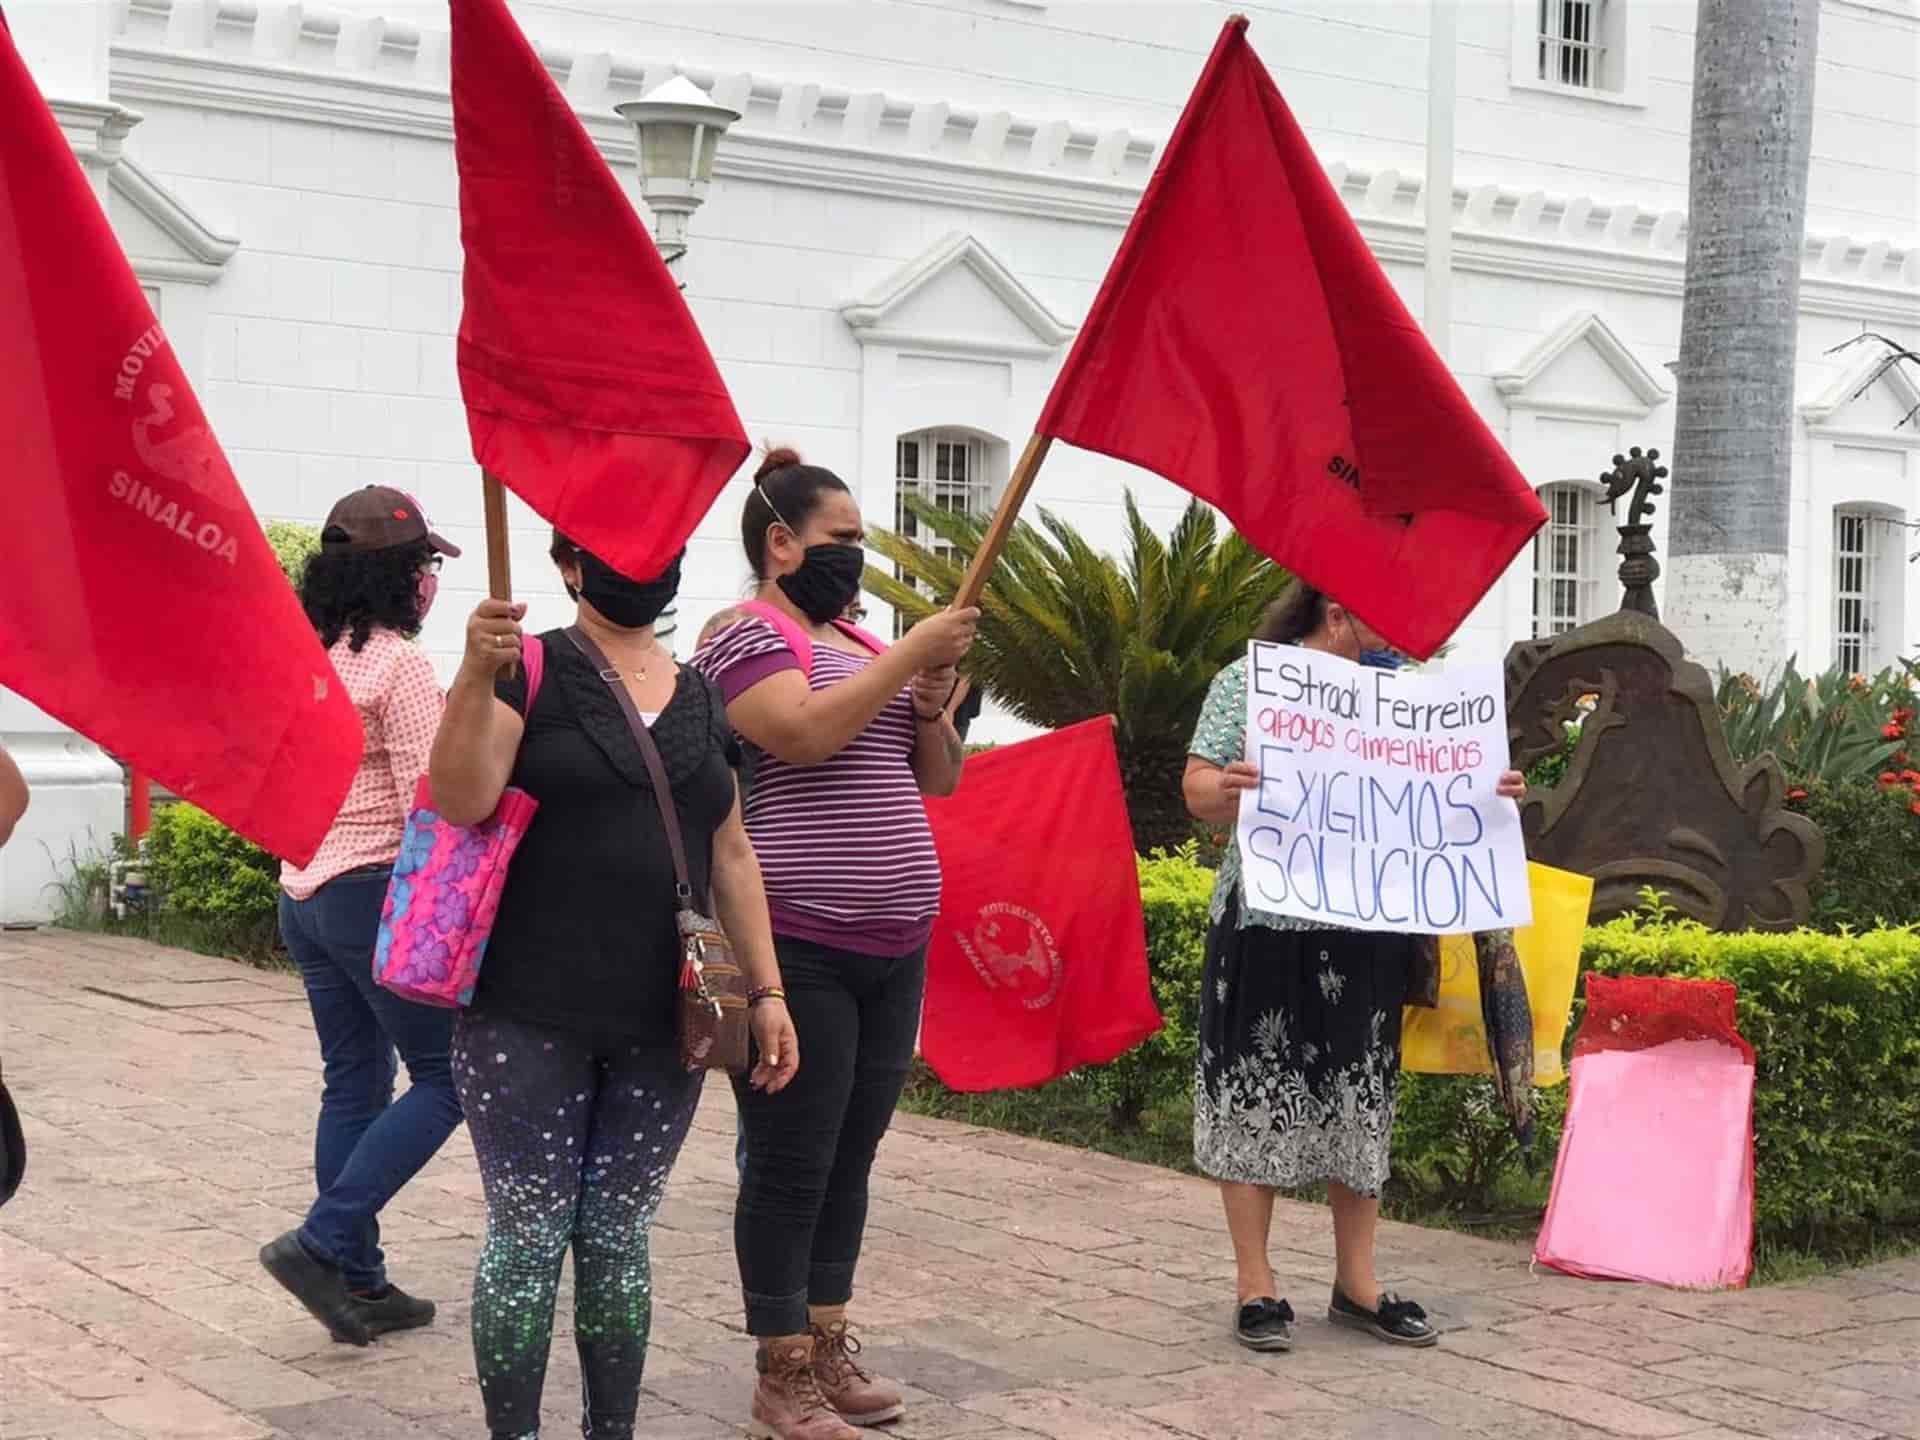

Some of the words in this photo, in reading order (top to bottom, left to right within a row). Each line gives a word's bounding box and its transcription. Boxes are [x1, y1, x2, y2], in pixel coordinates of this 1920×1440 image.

[108, 471, 239, 566] SINALOA
[1375, 671, 1495, 732] Ferreiro
[1257, 744, 1483, 850] EXIGIMOS
[1249, 825, 1503, 929] SOLUCIÓN
